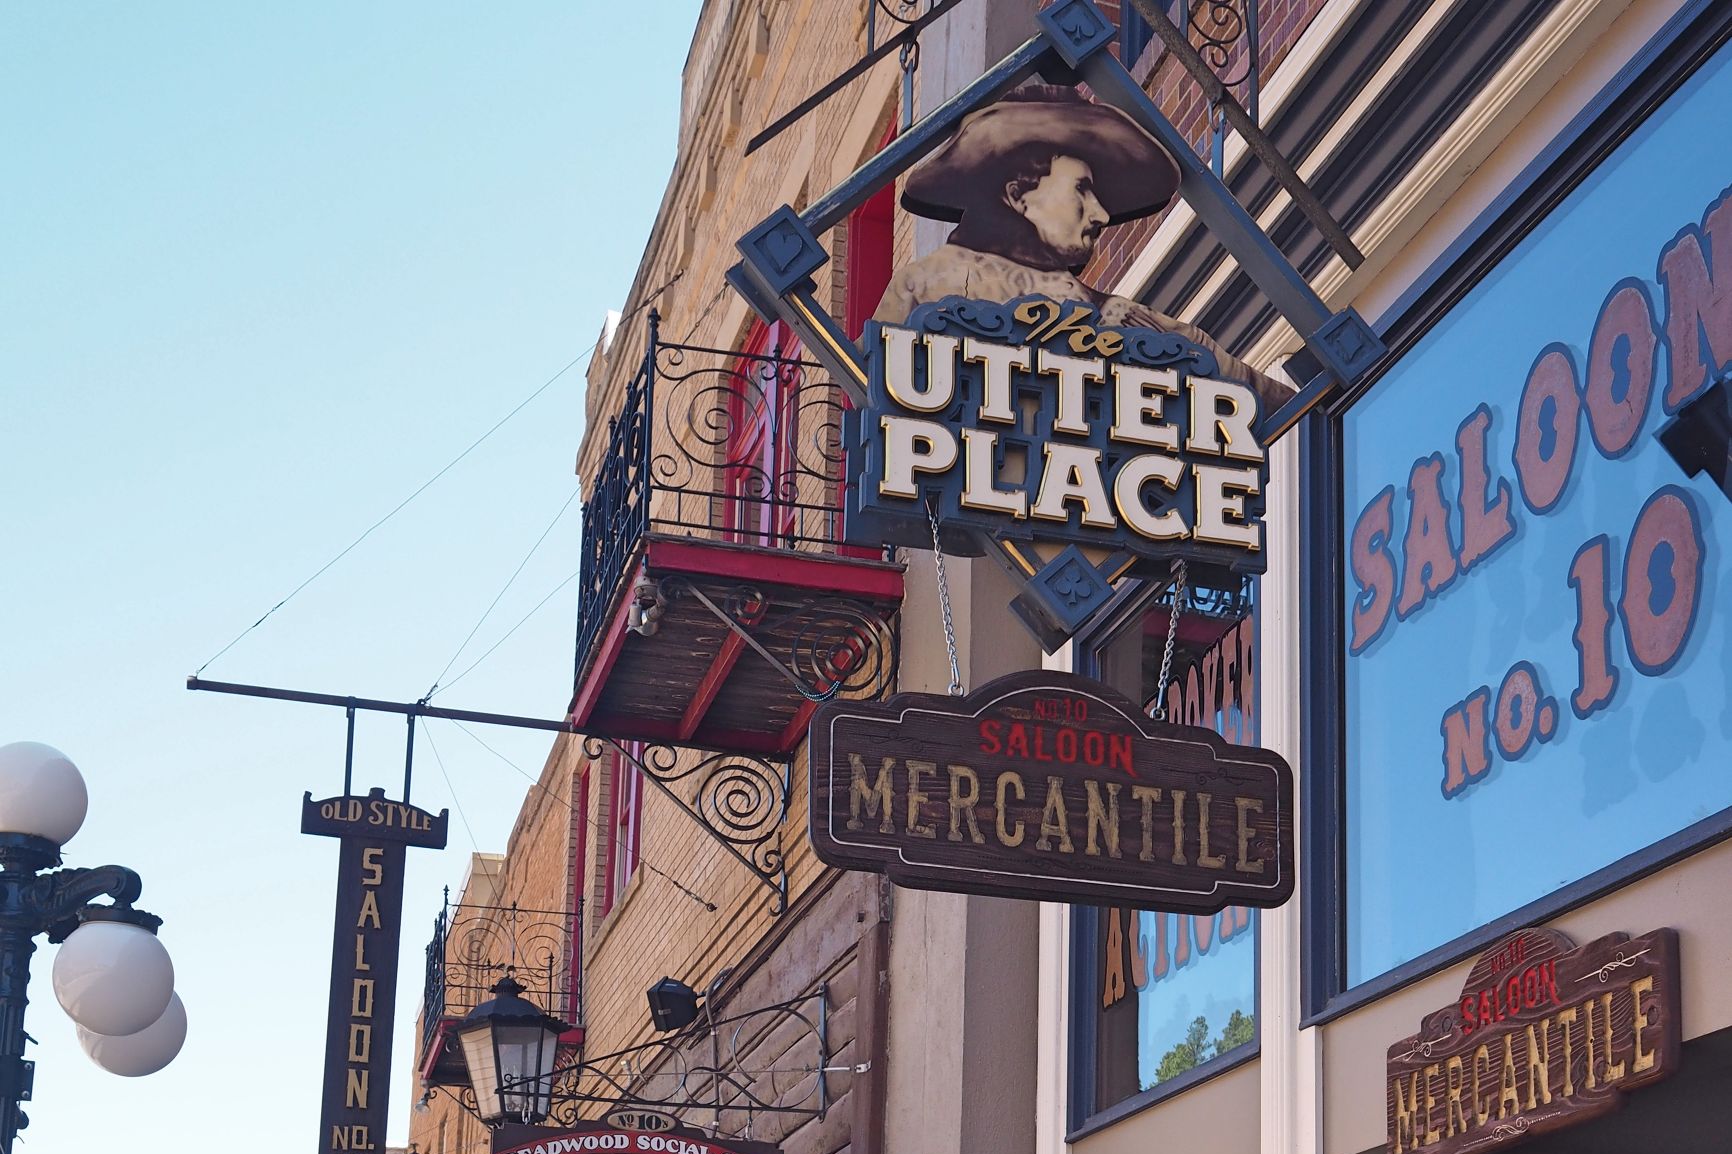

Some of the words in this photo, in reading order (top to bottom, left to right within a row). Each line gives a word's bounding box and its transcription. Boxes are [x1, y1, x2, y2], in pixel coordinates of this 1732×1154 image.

[1014, 299, 1124, 357] The
[881, 326, 1265, 462] UTTER
[1350, 184, 1732, 658] SALOON
[879, 415, 1261, 551] PLACE
[1568, 484, 1706, 720] 10
[846, 753, 1265, 873] MERCANTILE
[978, 720, 1141, 779] SALOON
[321, 800, 363, 824] OLD
[368, 800, 432, 832] STYLE
[345, 847, 385, 1110] SALOON
[1459, 959, 1562, 1036] SALOON
